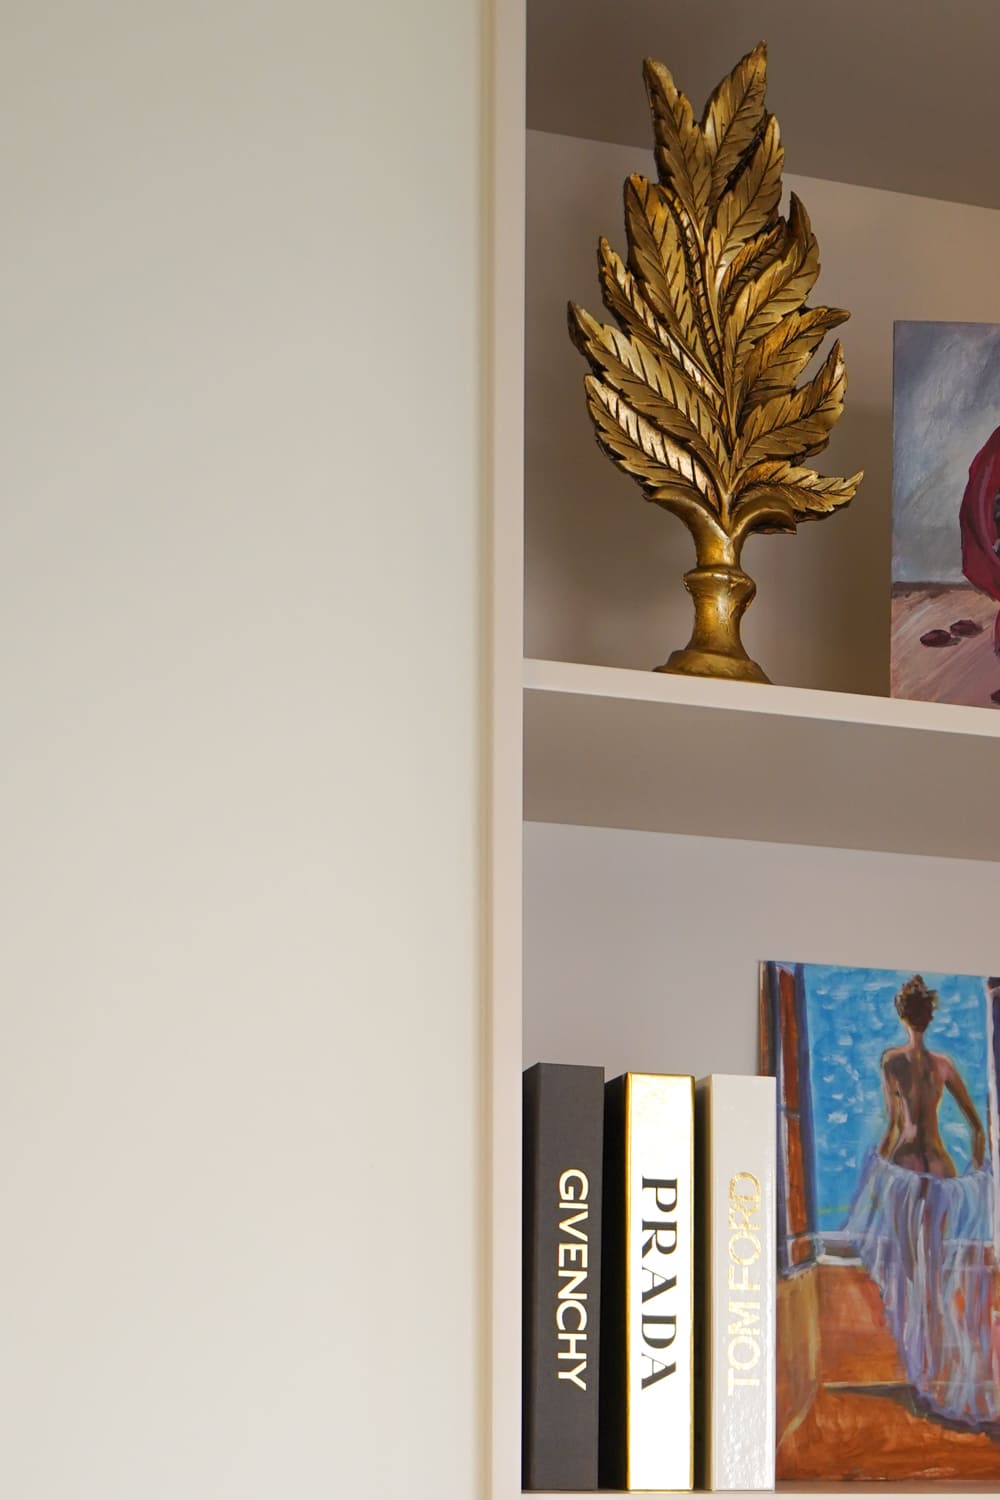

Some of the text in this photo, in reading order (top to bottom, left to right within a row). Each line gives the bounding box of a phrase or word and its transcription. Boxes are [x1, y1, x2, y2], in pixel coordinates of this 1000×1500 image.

[556, 1168, 589, 1391] GIVENCHY
[641, 1176, 678, 1390] PRADA
[727, 1172, 761, 1396] TOM FORD
